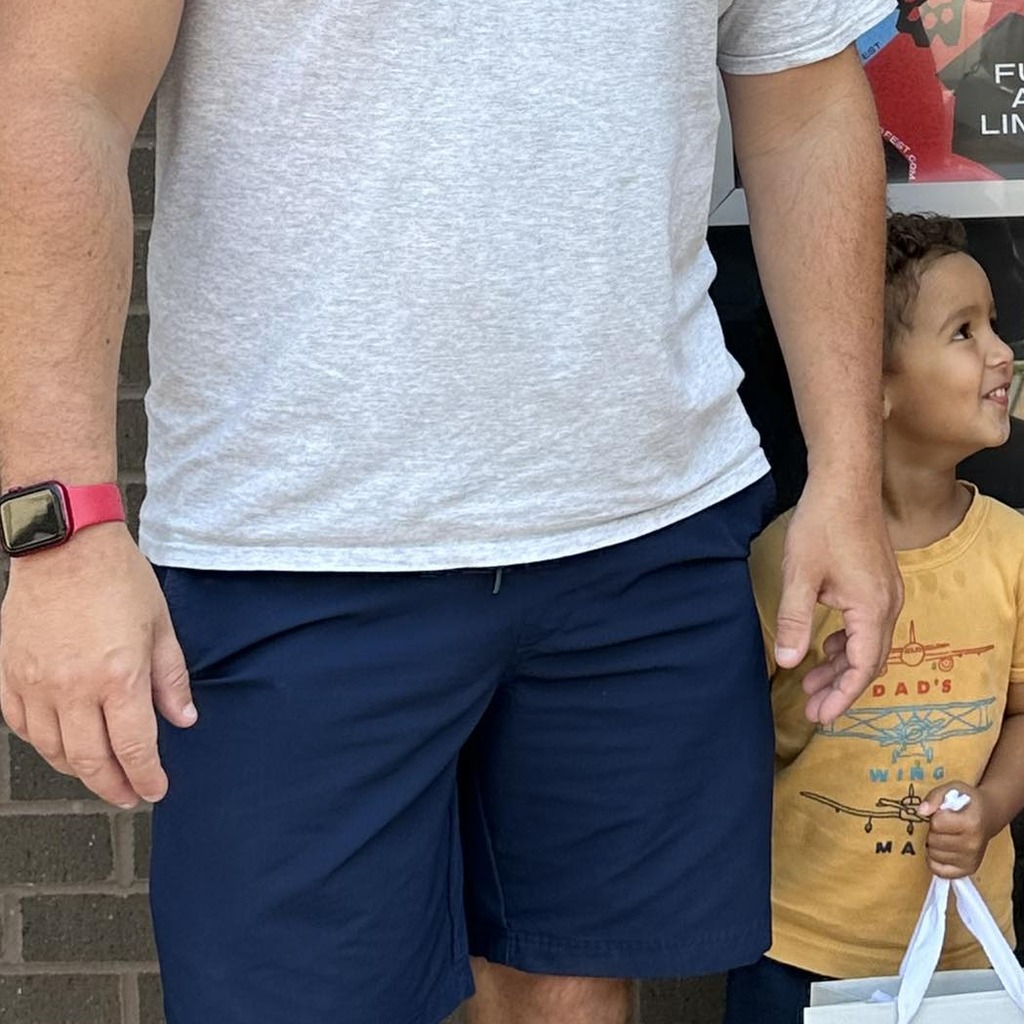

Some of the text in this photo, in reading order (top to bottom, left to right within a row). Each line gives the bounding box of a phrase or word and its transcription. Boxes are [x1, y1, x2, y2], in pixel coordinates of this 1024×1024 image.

[872, 679, 952, 697] DAD'S
[869, 766, 944, 782] WING
[876, 840, 929, 856] MA
